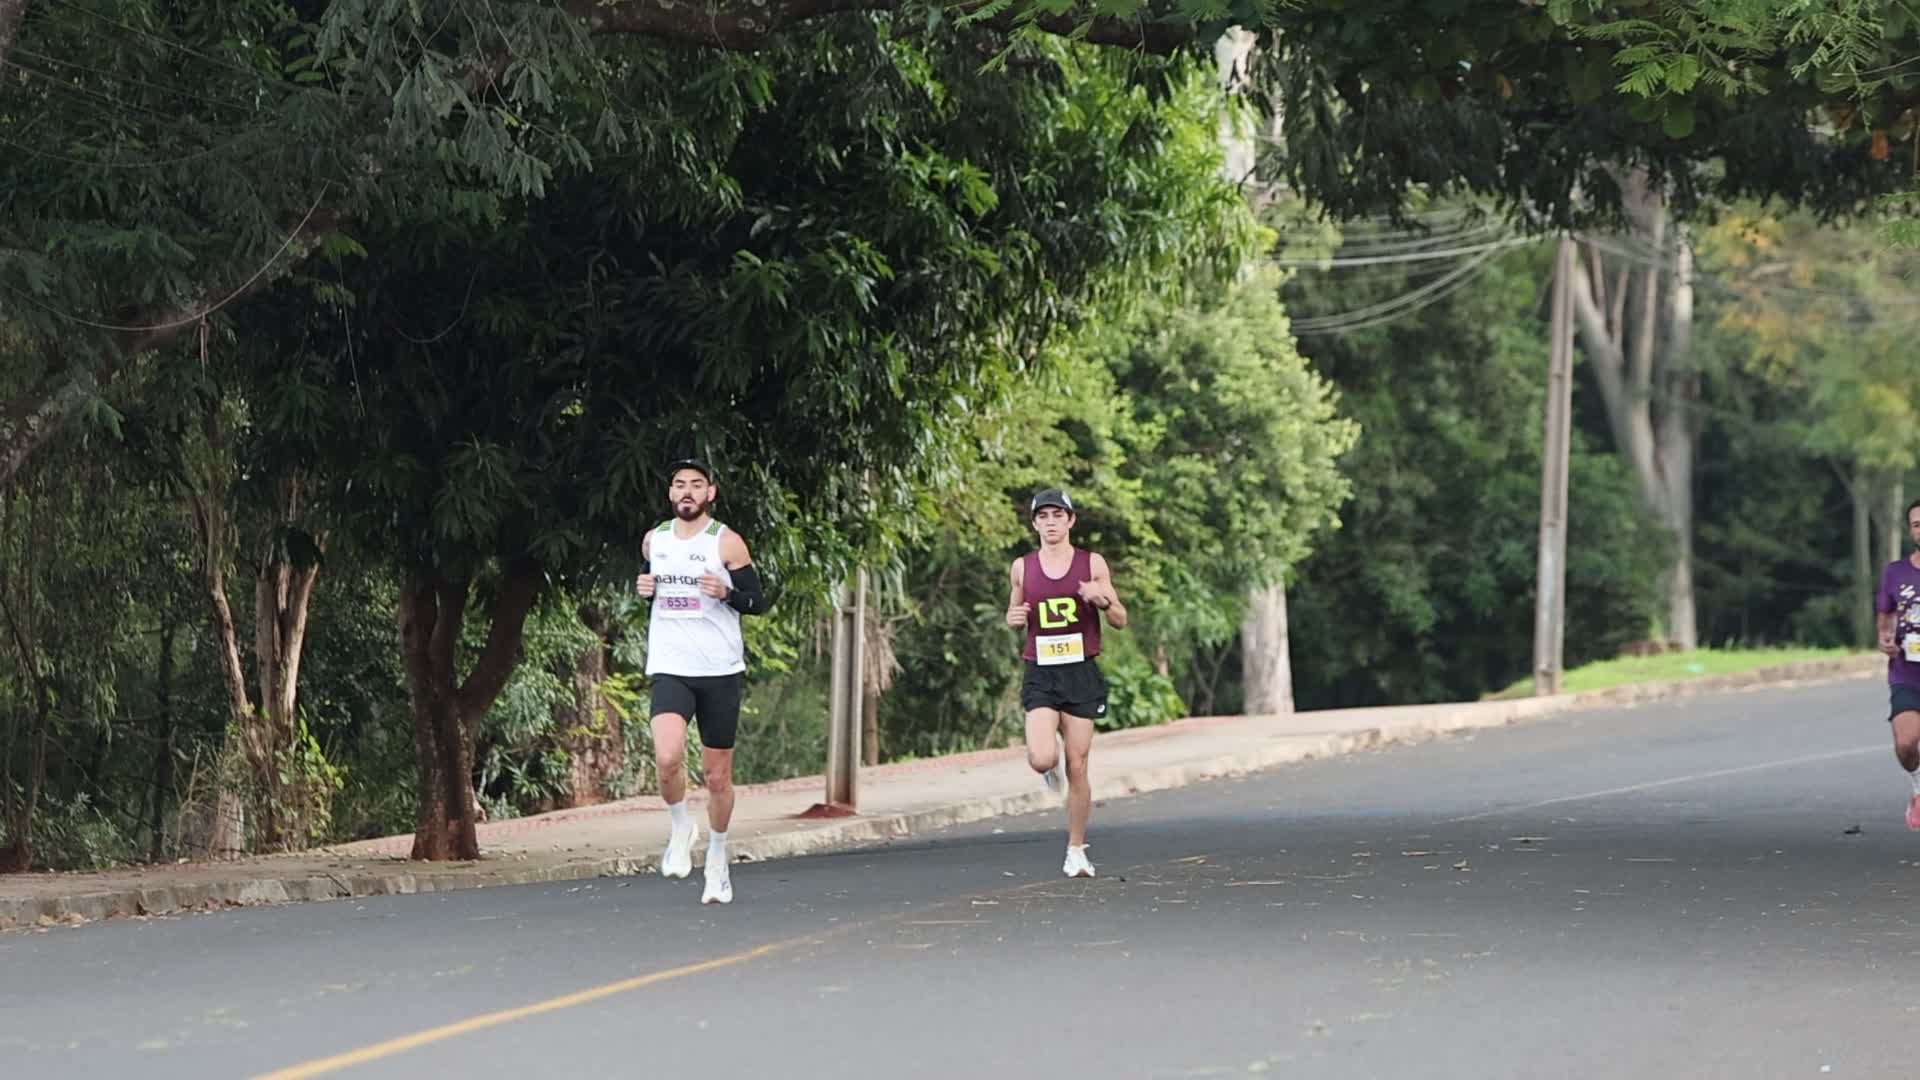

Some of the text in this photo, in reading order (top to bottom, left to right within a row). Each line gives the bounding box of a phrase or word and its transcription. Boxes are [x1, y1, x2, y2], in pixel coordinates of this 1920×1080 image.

[667, 597, 689, 608] 653
[1038, 597, 1079, 629] LR
[1050, 642, 1070, 655] 151
